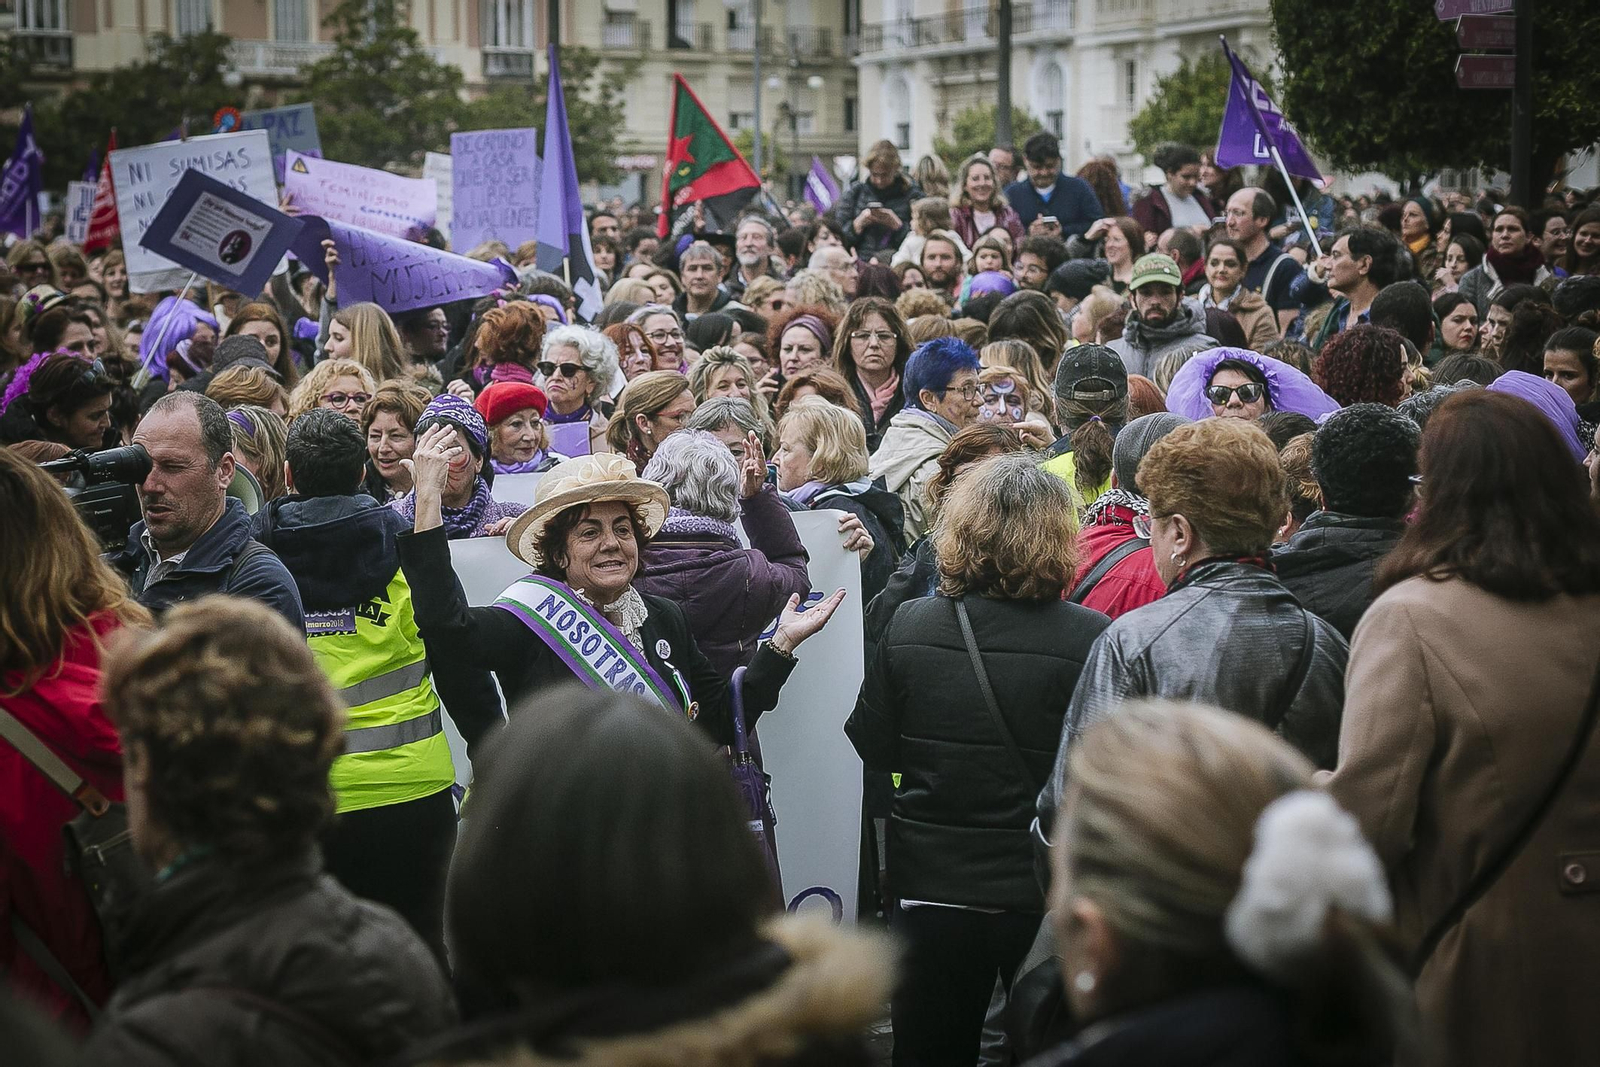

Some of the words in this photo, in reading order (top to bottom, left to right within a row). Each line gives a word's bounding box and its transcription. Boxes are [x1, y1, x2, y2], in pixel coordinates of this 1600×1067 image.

[262, 110, 306, 139] PAZ
[474, 132, 527, 152] CAMINO
[128, 162, 152, 186] NI
[169, 148, 250, 178] SUMISAS
[133, 192, 155, 212] NI
[534, 593, 646, 696] NOSOTRAS
